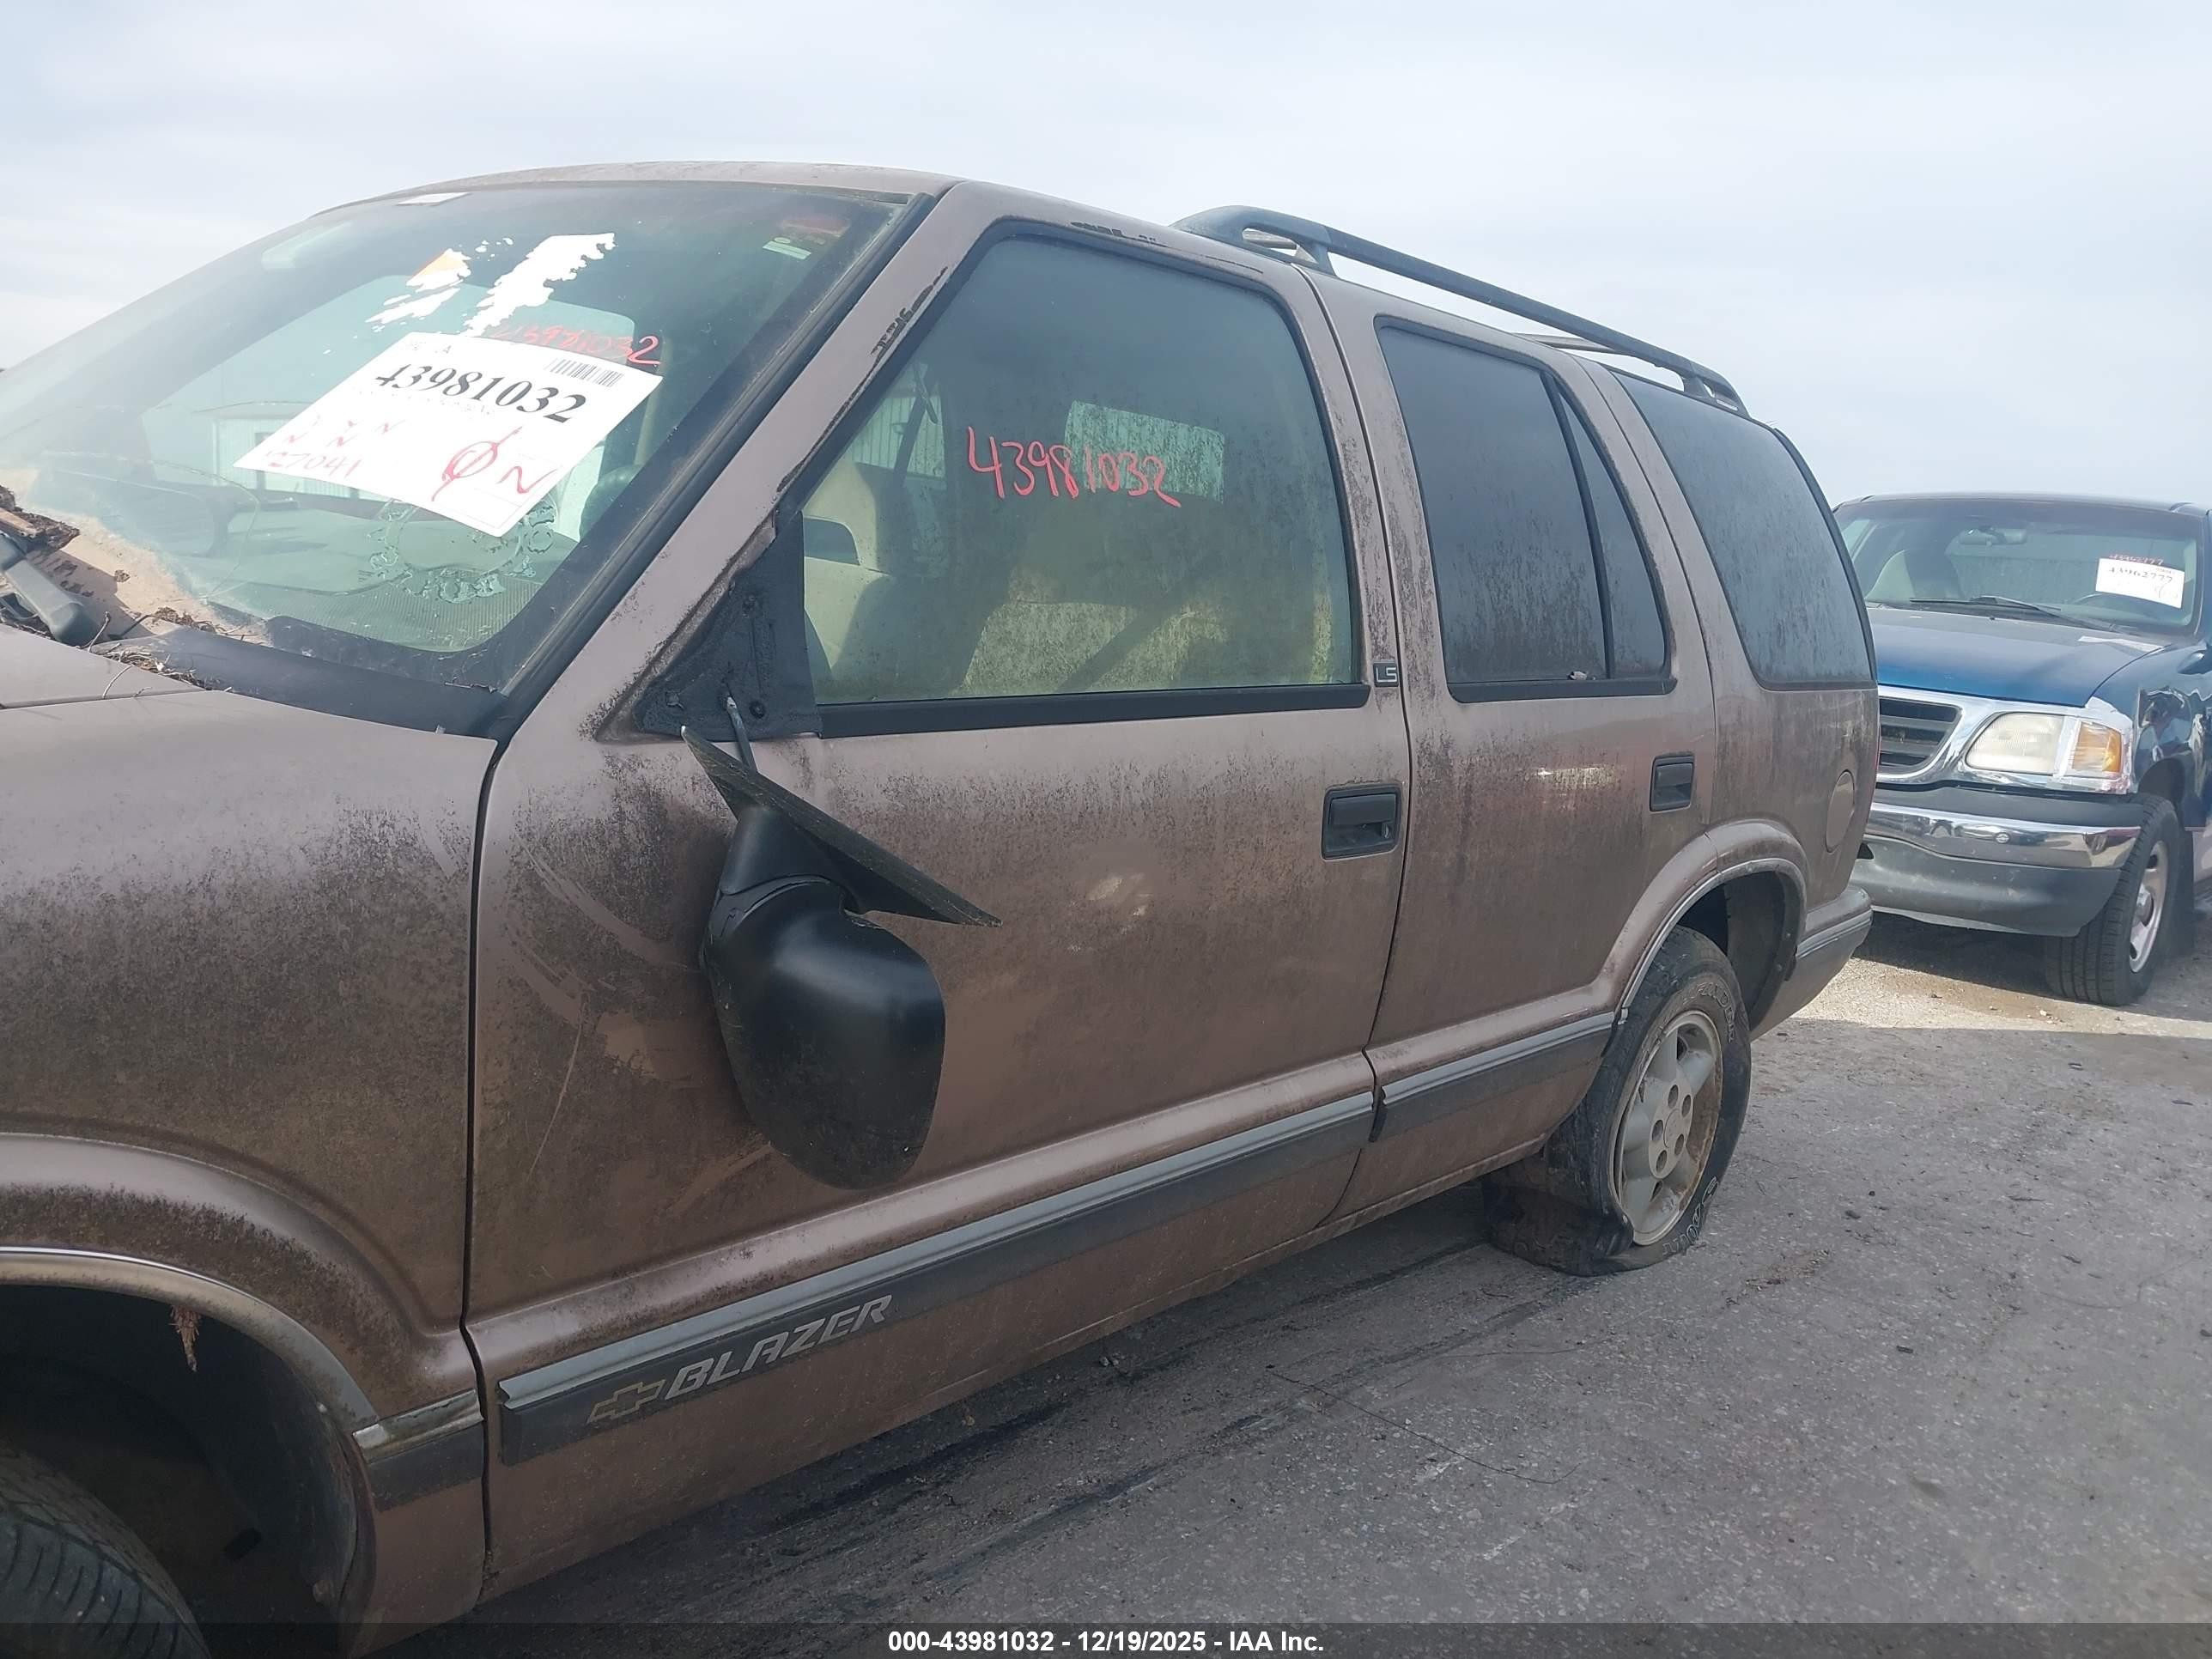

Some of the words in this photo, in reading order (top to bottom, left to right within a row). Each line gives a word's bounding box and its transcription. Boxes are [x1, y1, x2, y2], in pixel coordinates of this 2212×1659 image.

[375, 364, 586, 423] 43981032
[969, 426, 1182, 508] 43981032
[1376, 667, 1398, 683] LS
[664, 1294, 894, 1401] BLAZER
